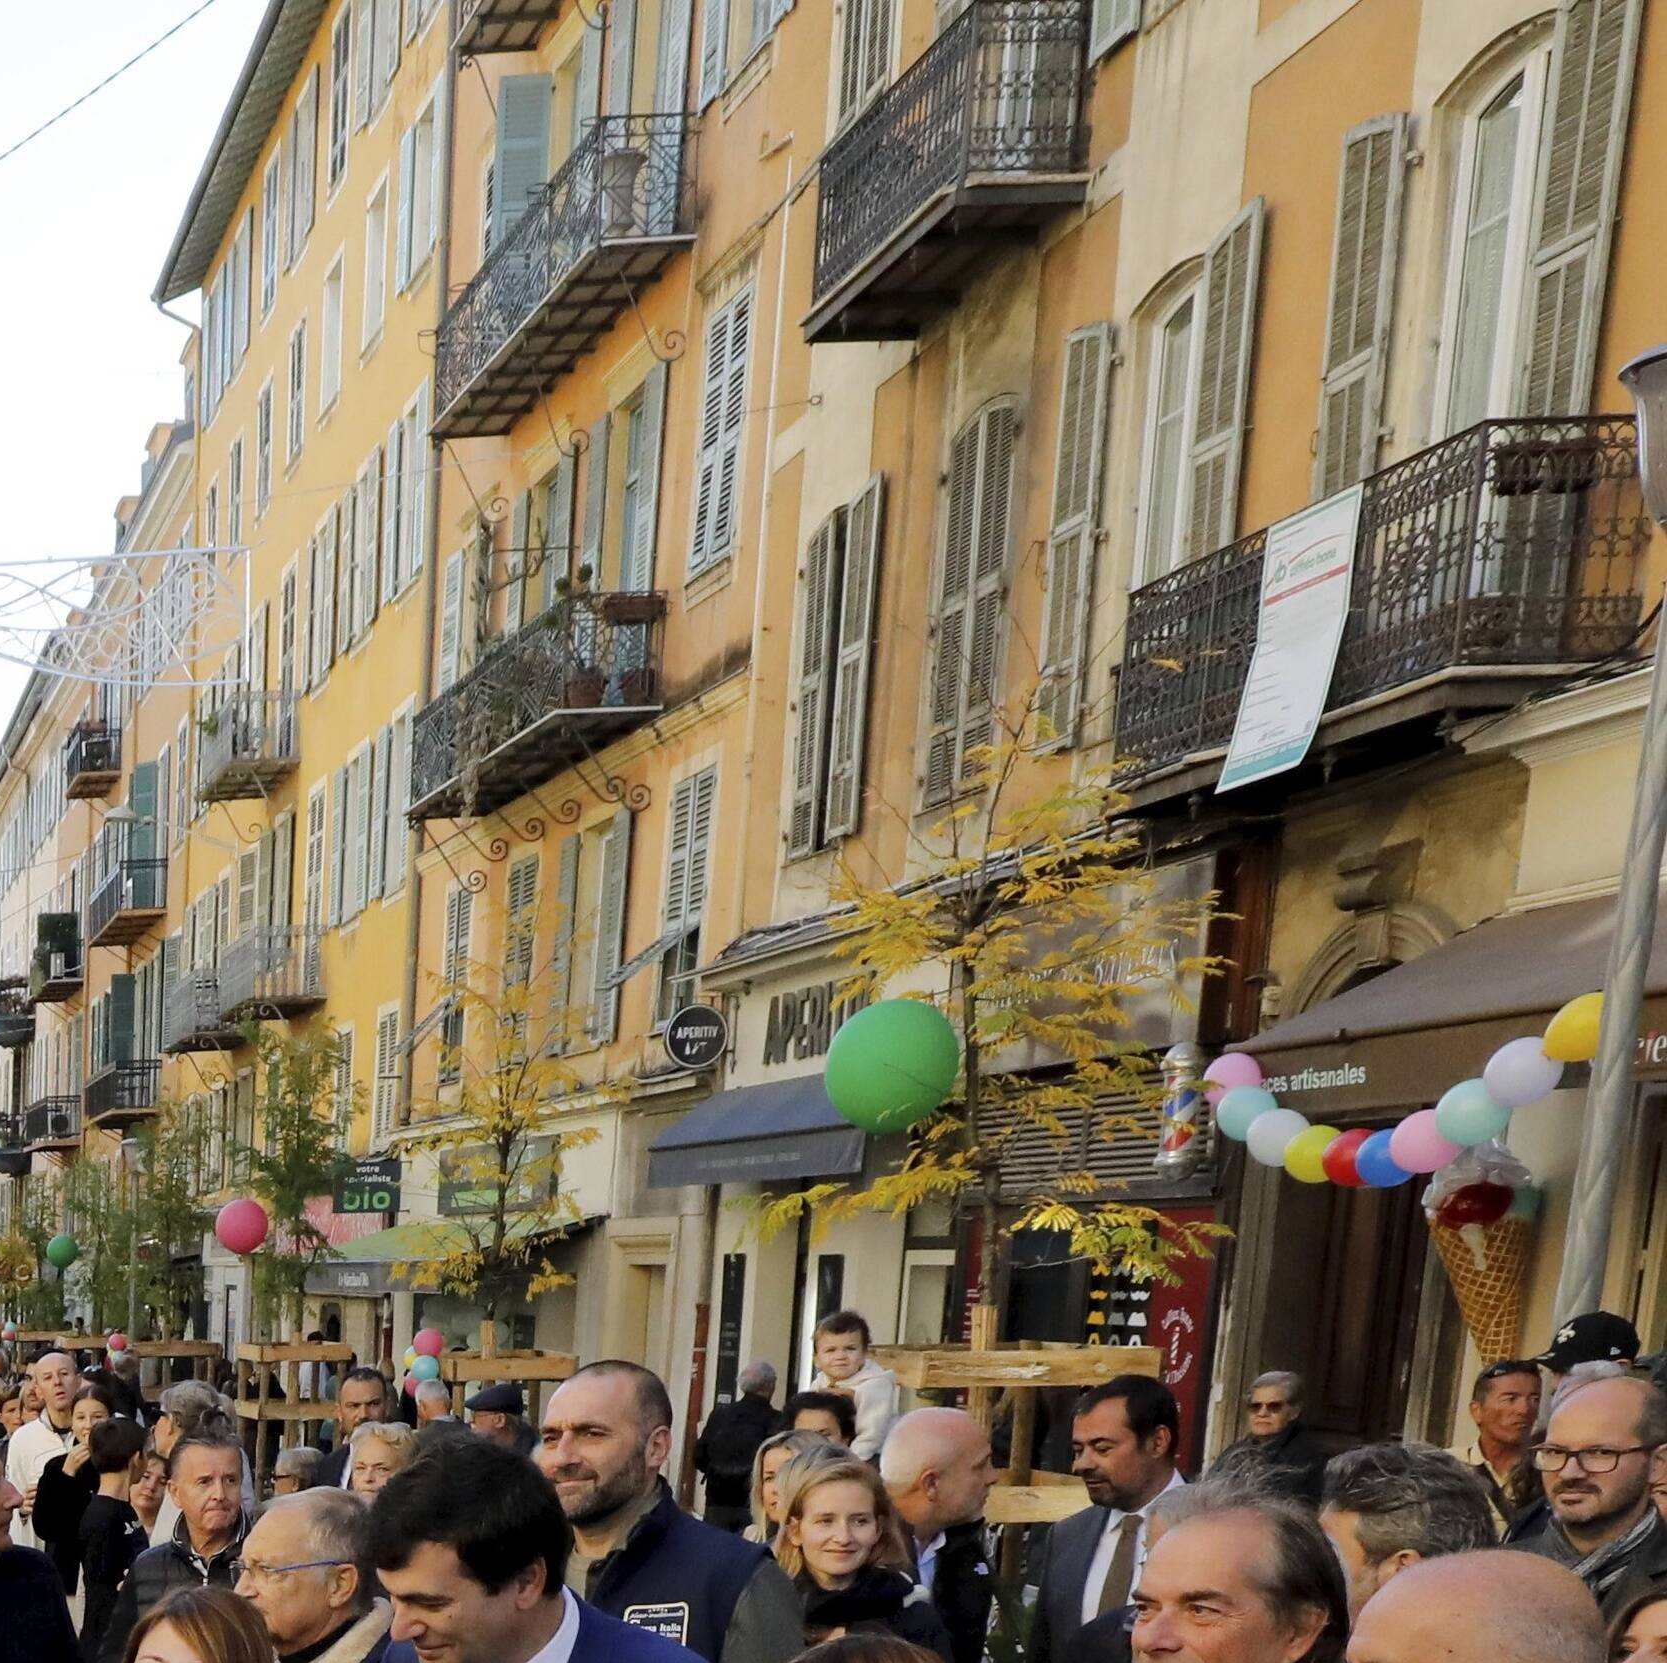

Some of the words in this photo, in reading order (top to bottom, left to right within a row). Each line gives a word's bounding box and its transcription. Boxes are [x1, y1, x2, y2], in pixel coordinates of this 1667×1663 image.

[762, 971, 875, 1067] APERI
[1290, 1062, 1366, 1091] artisanales
[355, 1165, 380, 1173] votre
[343, 1186, 391, 1211] bio
